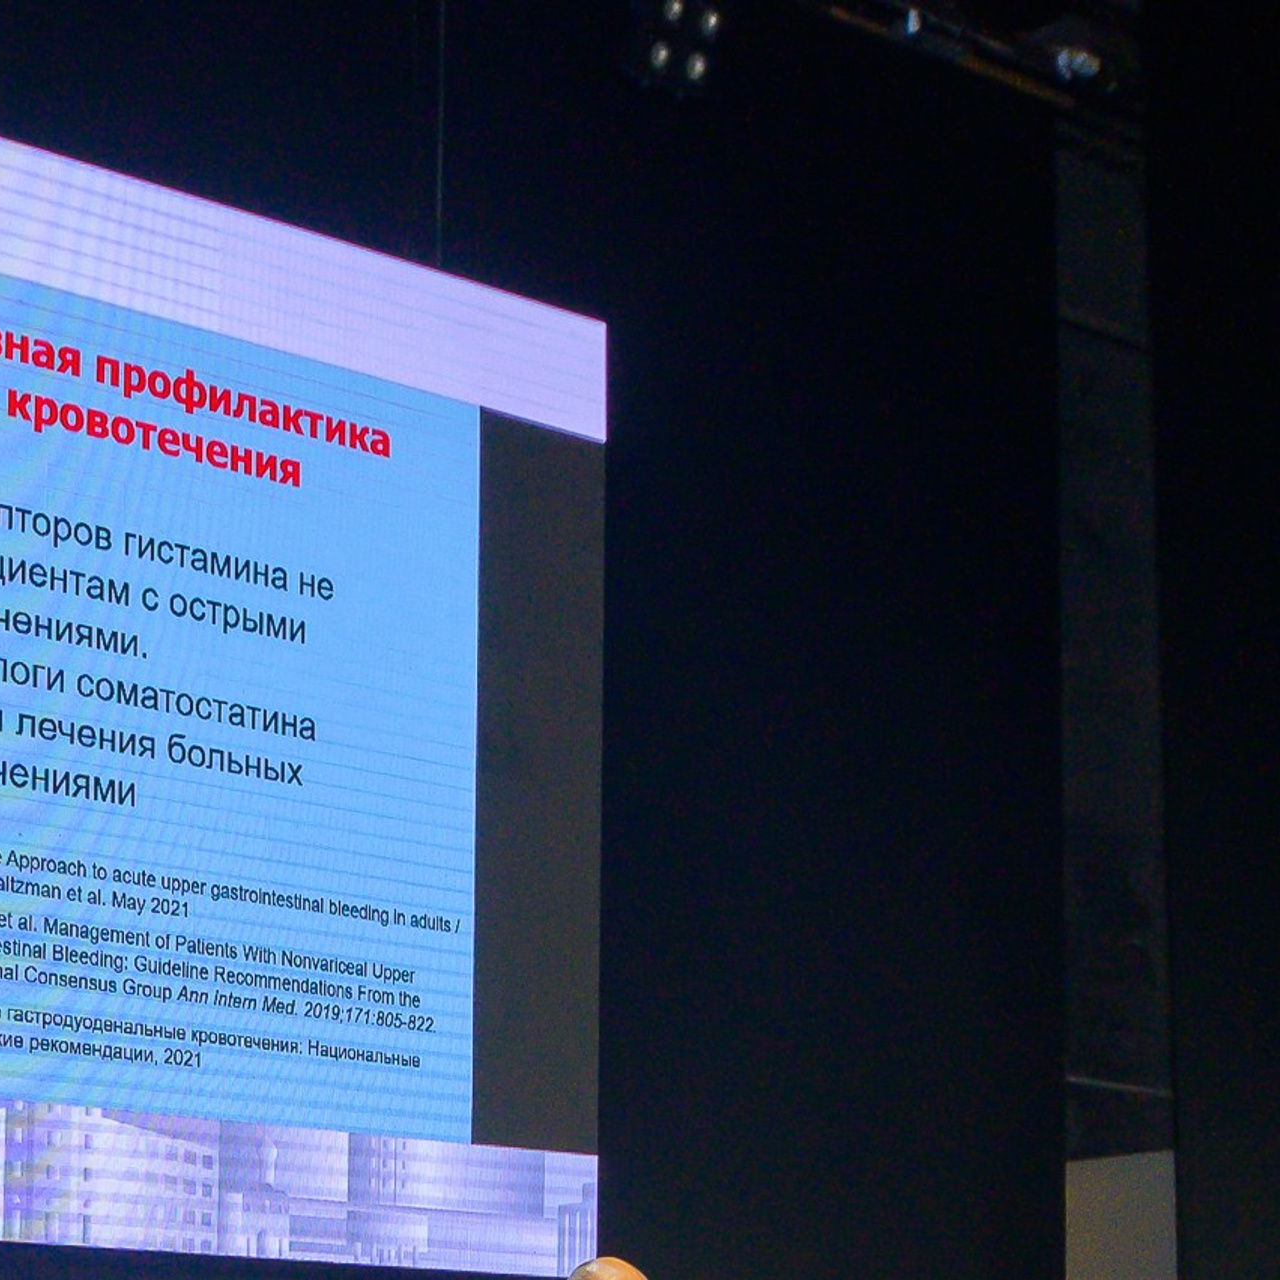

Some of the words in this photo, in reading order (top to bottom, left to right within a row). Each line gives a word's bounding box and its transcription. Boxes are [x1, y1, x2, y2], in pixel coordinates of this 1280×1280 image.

[7, 388, 301, 488] кровотечения
[96, 355, 391, 458] профилактика
[124, 531, 288, 592] гистамина
[299, 571, 334, 601] не
[141, 587, 159, 612] с
[169, 593, 306, 645] острыми
[76, 673, 316, 742] соматостатина
[15, 712, 156, 760] лечения
[167, 733, 303, 787] больных
[5, 849, 88, 878] Approach
[92, 862, 108, 881] to
[112, 868, 157, 889] acute
[161, 876, 207, 897] upper
[210, 883, 324, 914] gastrointestinal
[328, 899, 390, 928] bleeding
[393, 908, 406, 926] in
[409, 913, 452, 933] adults
[66, 886, 83, 903] et
[86, 888, 107, 906] al.
[111, 890, 147, 916] May
[150, 896, 189, 918] 2021
[17, 914, 37, 932] al.
[43, 916, 151, 948] Management
[154, 933, 171, 951] of
[175, 934, 238, 960] Patients
[242, 944, 277, 965] With
[281, 949, 368, 978] Nonvariceal
[372, 962, 415, 985] Upper
[52, 943, 129, 974] Bleeding:
[134, 954, 209, 981] Guideline
[214, 965, 353, 1000] Recommendations
[357, 985, 395, 1005] From
[398, 991, 421, 1009] the
[24, 965, 117, 993] Consensus
[122, 977, 173, 1004] Group
[176, 984, 209, 1005] Ann
[213, 989, 257, 1011] Intern
[261, 995, 298, 1016] Med.
[7, 1007, 187, 1041] гастродуоденальные
[191, 1029, 303, 1055] кровотечения:
[307, 1039, 421, 1069] Национальные
[29, 1036, 158, 1066] рекомендации,
[163, 1047, 201, 1068] 2021
